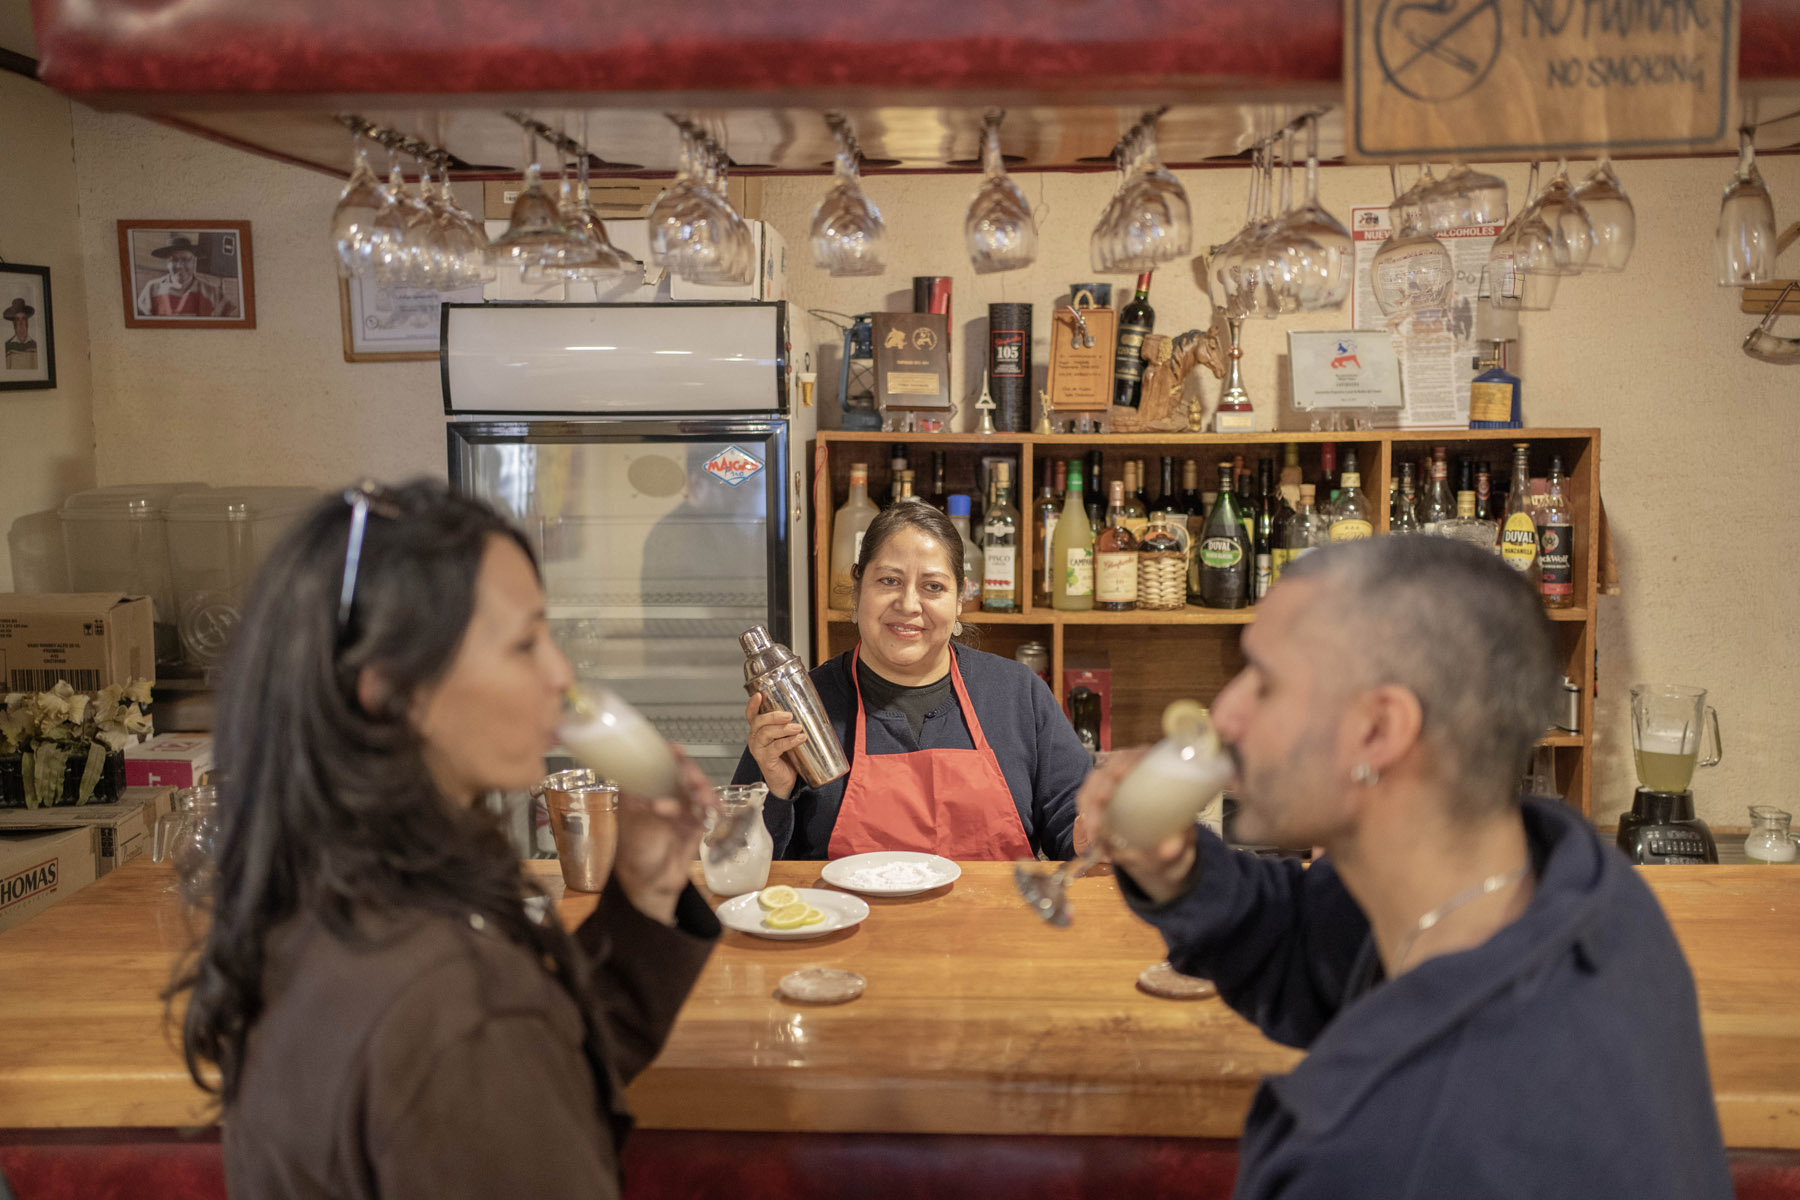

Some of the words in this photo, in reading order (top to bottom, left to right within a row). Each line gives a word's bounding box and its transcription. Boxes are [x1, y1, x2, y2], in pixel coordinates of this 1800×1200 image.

[1547, 57, 1583, 88] NO
[1586, 55, 1706, 92] SMOKING
[1436, 226, 1496, 238] ALCOHOLES
[997, 345, 1019, 359] 105
[1505, 531, 1533, 543] DUVAL
[0, 862, 56, 905] HOMAS
